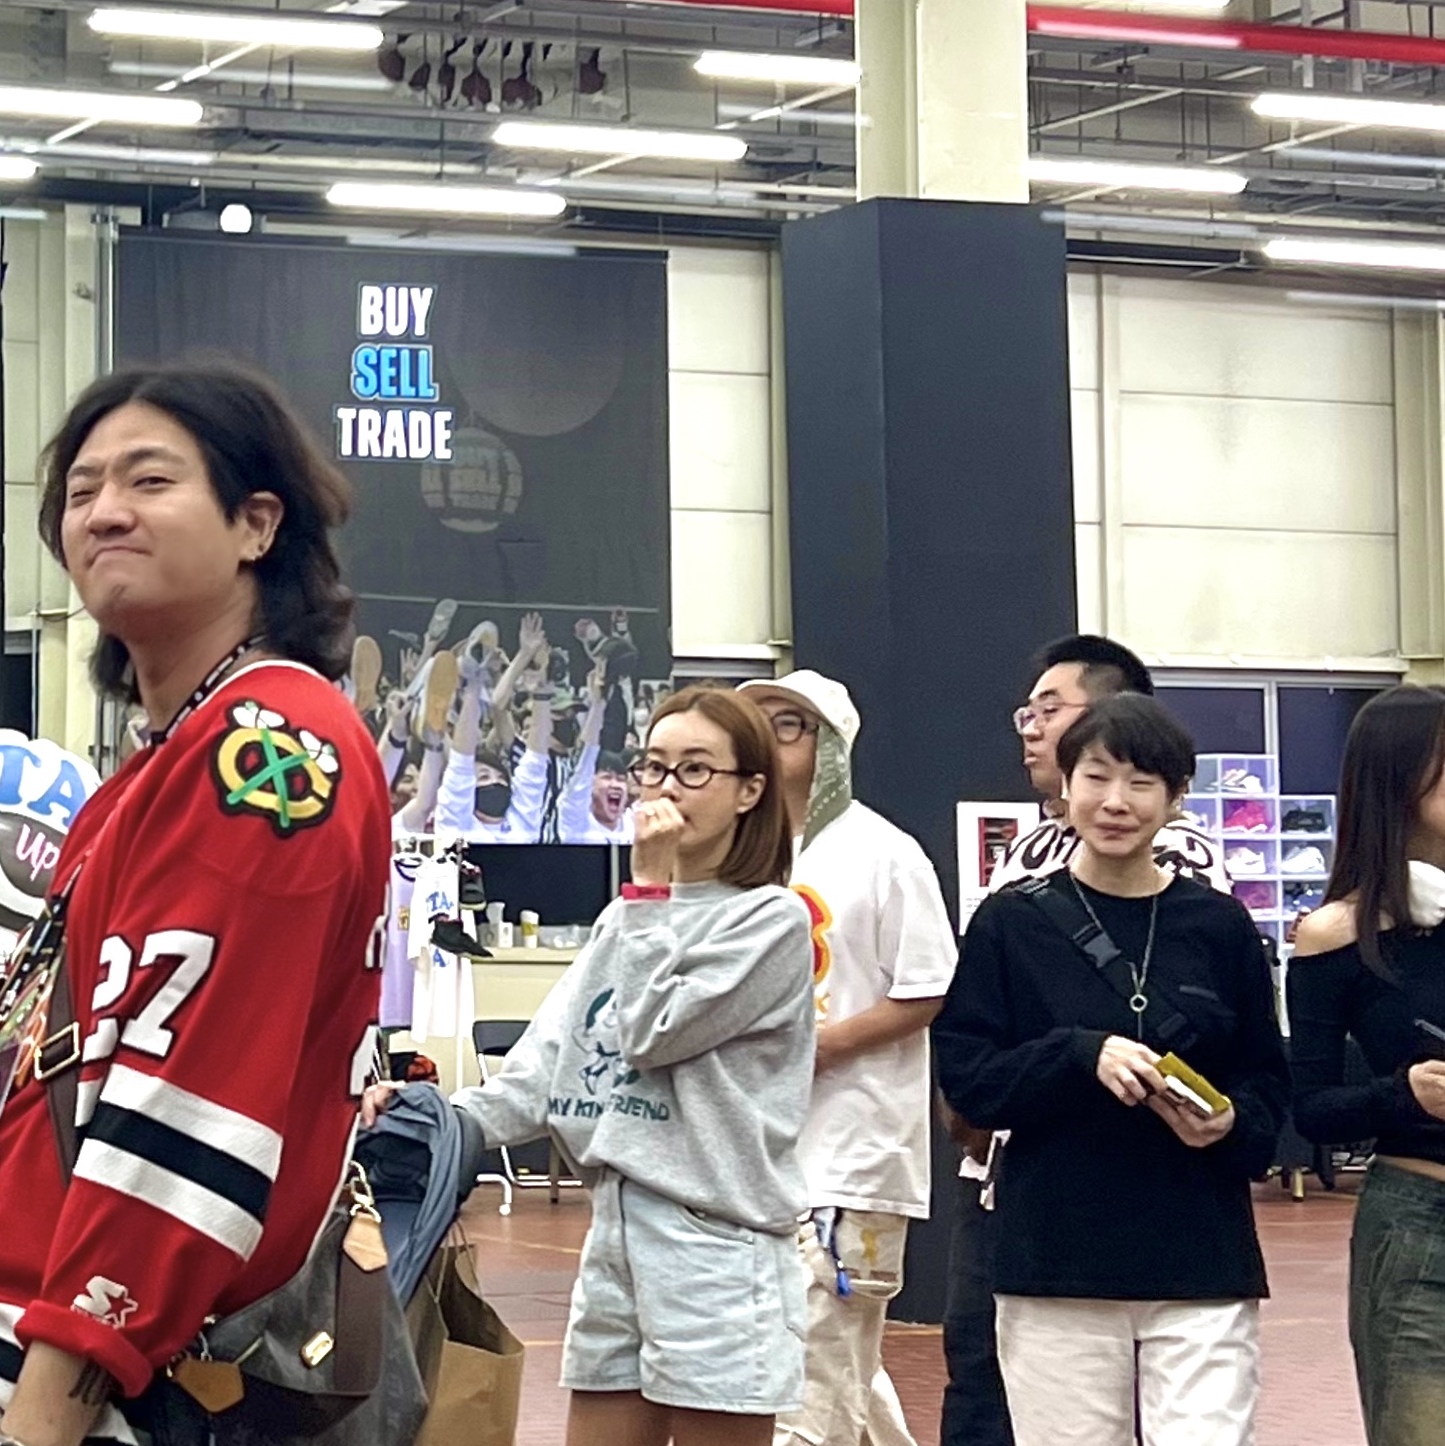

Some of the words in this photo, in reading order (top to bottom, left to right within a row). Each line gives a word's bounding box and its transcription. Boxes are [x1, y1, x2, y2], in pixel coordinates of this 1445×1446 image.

[360, 285, 433, 336] BUY
[354, 346, 435, 398] SELL
[337, 407, 452, 459] TRADE
[82, 929, 215, 1063] 27
